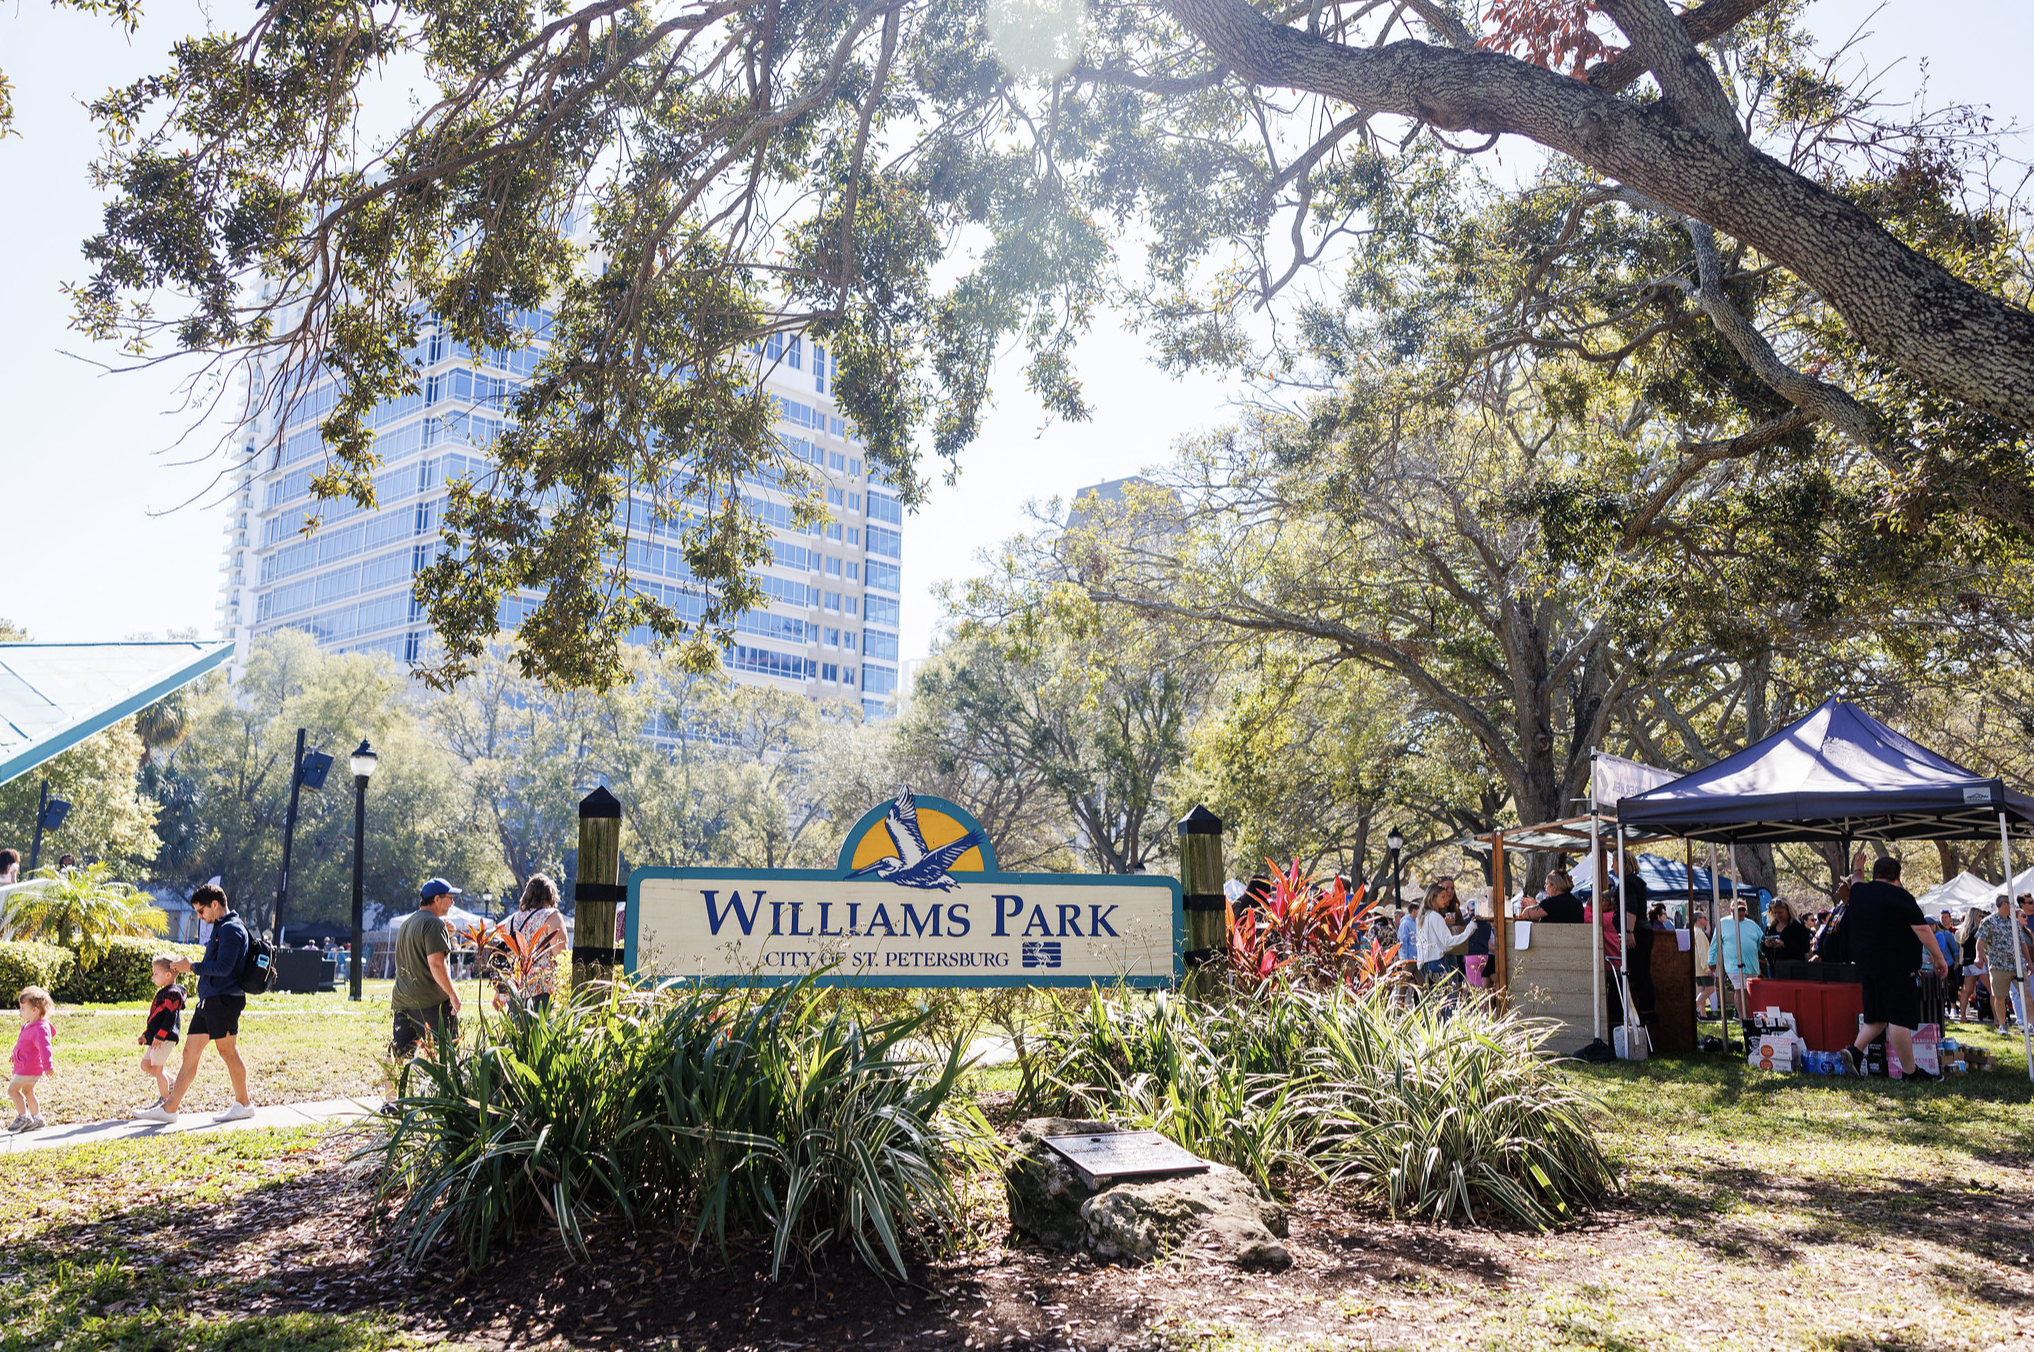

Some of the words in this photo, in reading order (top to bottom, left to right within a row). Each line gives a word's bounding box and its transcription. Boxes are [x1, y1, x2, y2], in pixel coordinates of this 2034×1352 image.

[700, 890, 971, 938] WILLIAMS
[991, 895, 1121, 937] PARK
[766, 951, 816, 967] CITY
[820, 952, 847, 967] OF
[852, 952, 879, 967] ST.
[886, 952, 1009, 967] PETERSBURG
